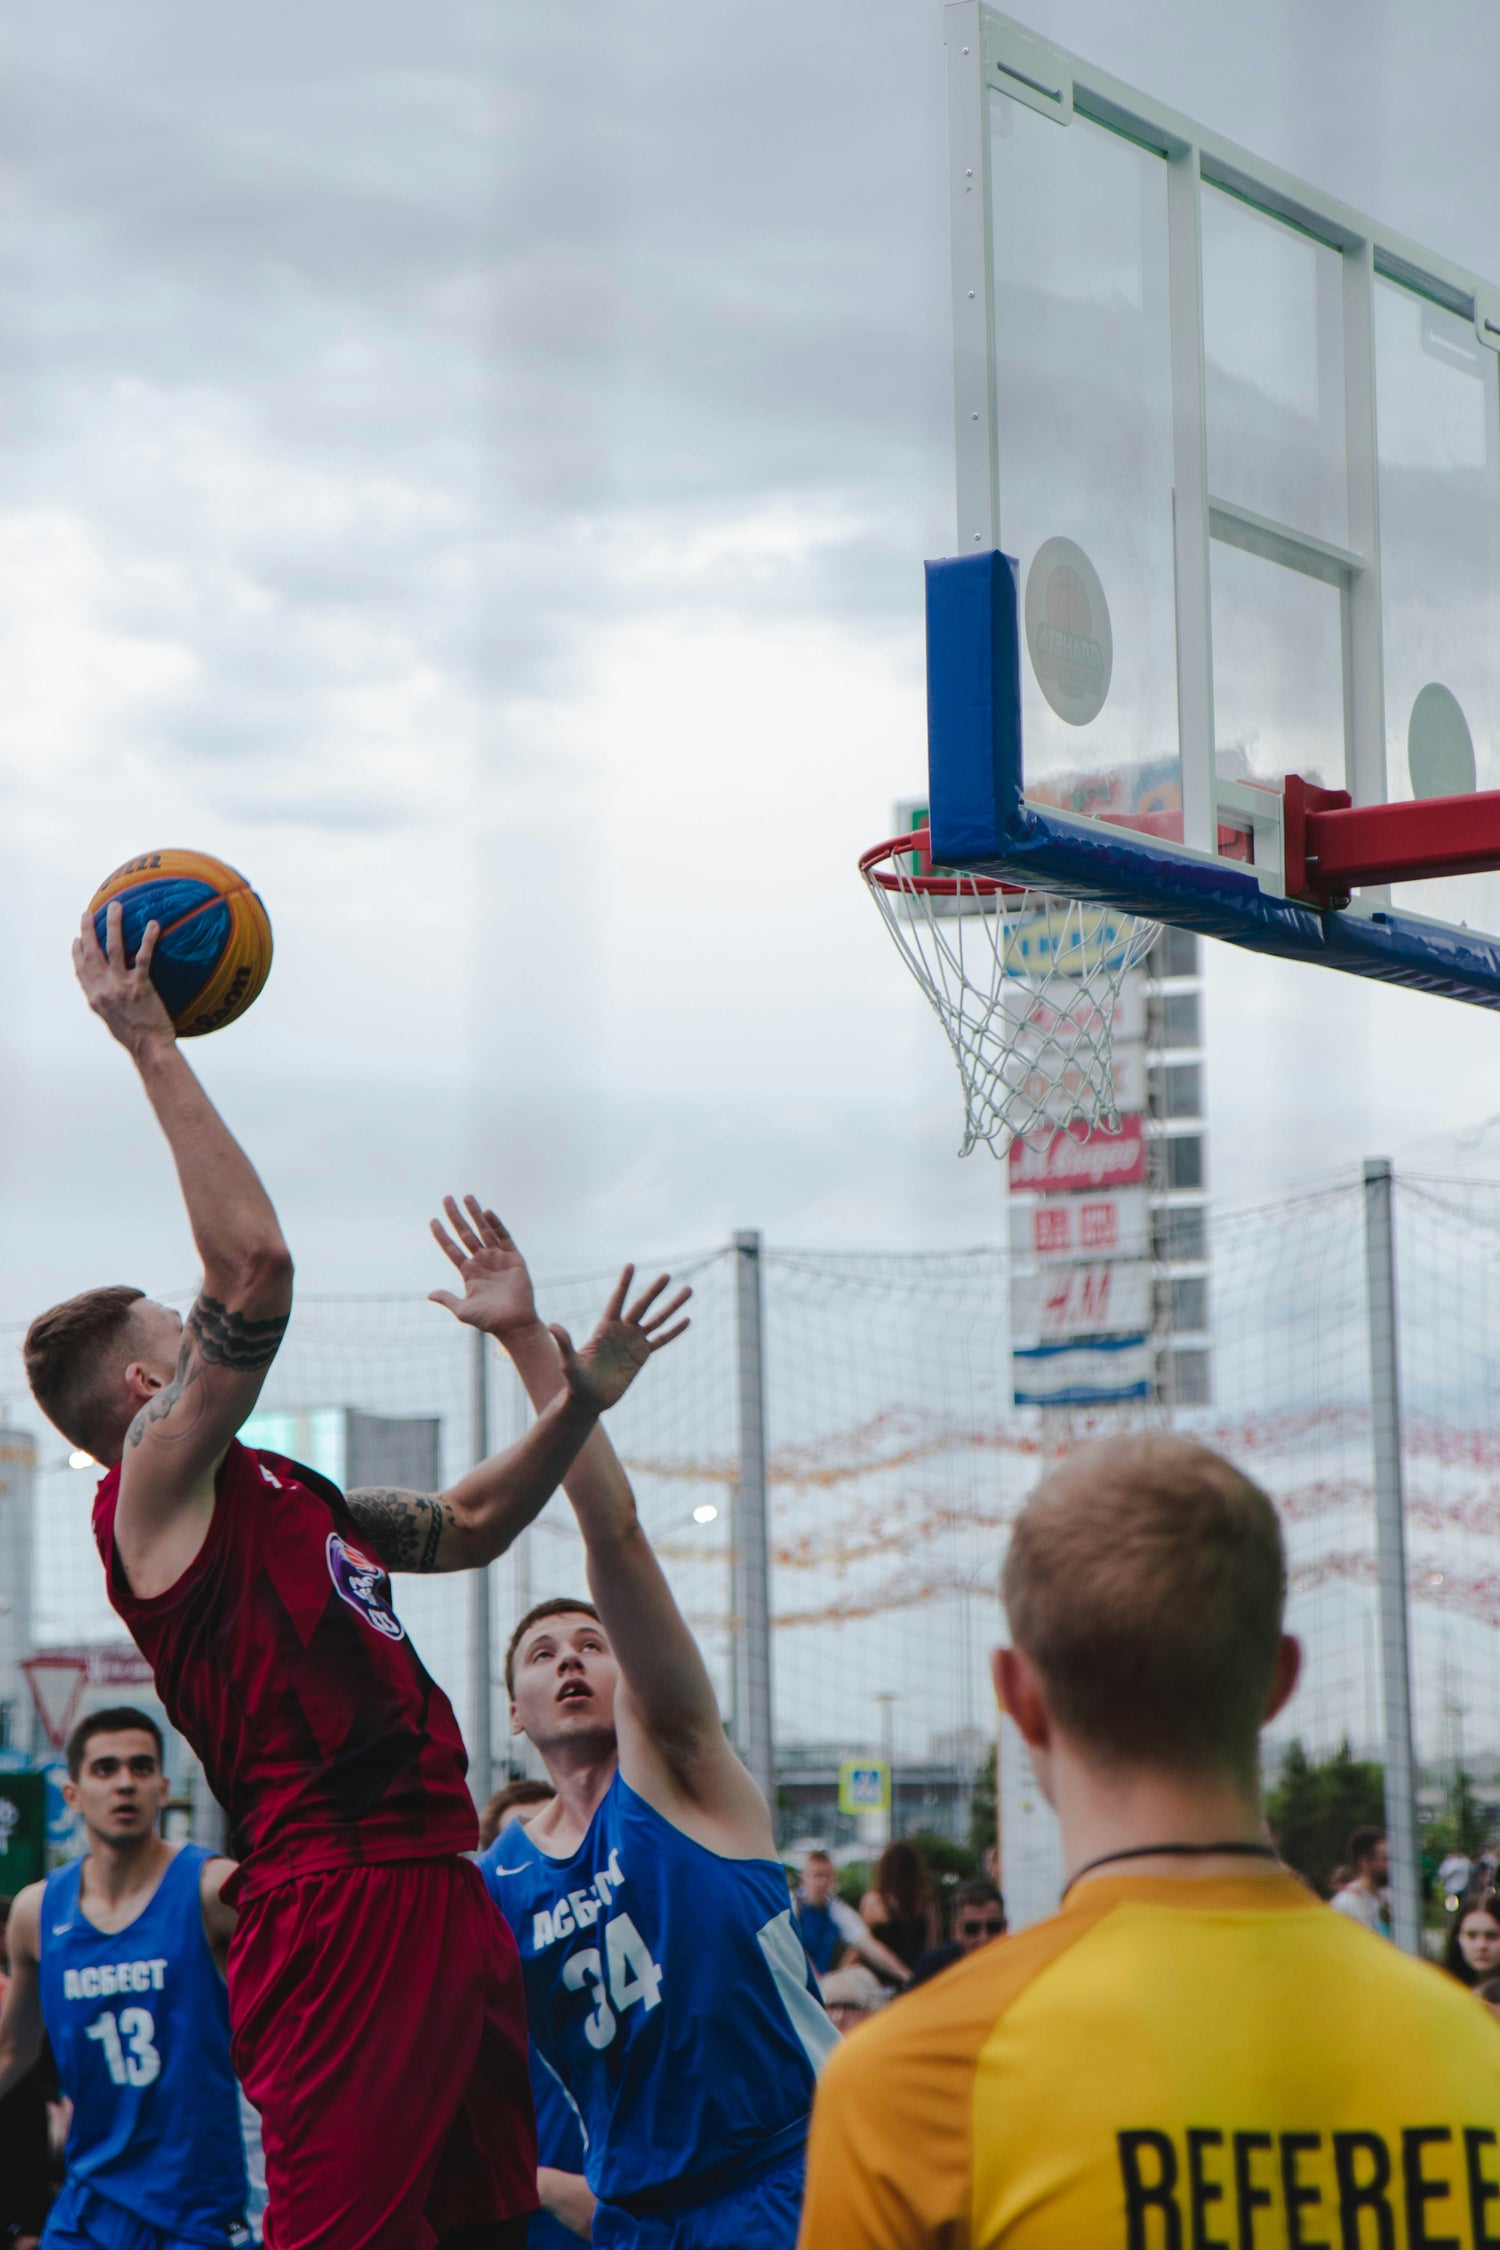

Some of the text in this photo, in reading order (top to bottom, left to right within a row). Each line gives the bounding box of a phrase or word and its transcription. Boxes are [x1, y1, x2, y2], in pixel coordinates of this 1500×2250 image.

[64, 1958, 168, 1999] АСБЕСТ
[562, 1912, 663, 2049] 34
[84, 2007, 161, 2087] 13
[1116, 2124, 1500, 2250] REFEREE
